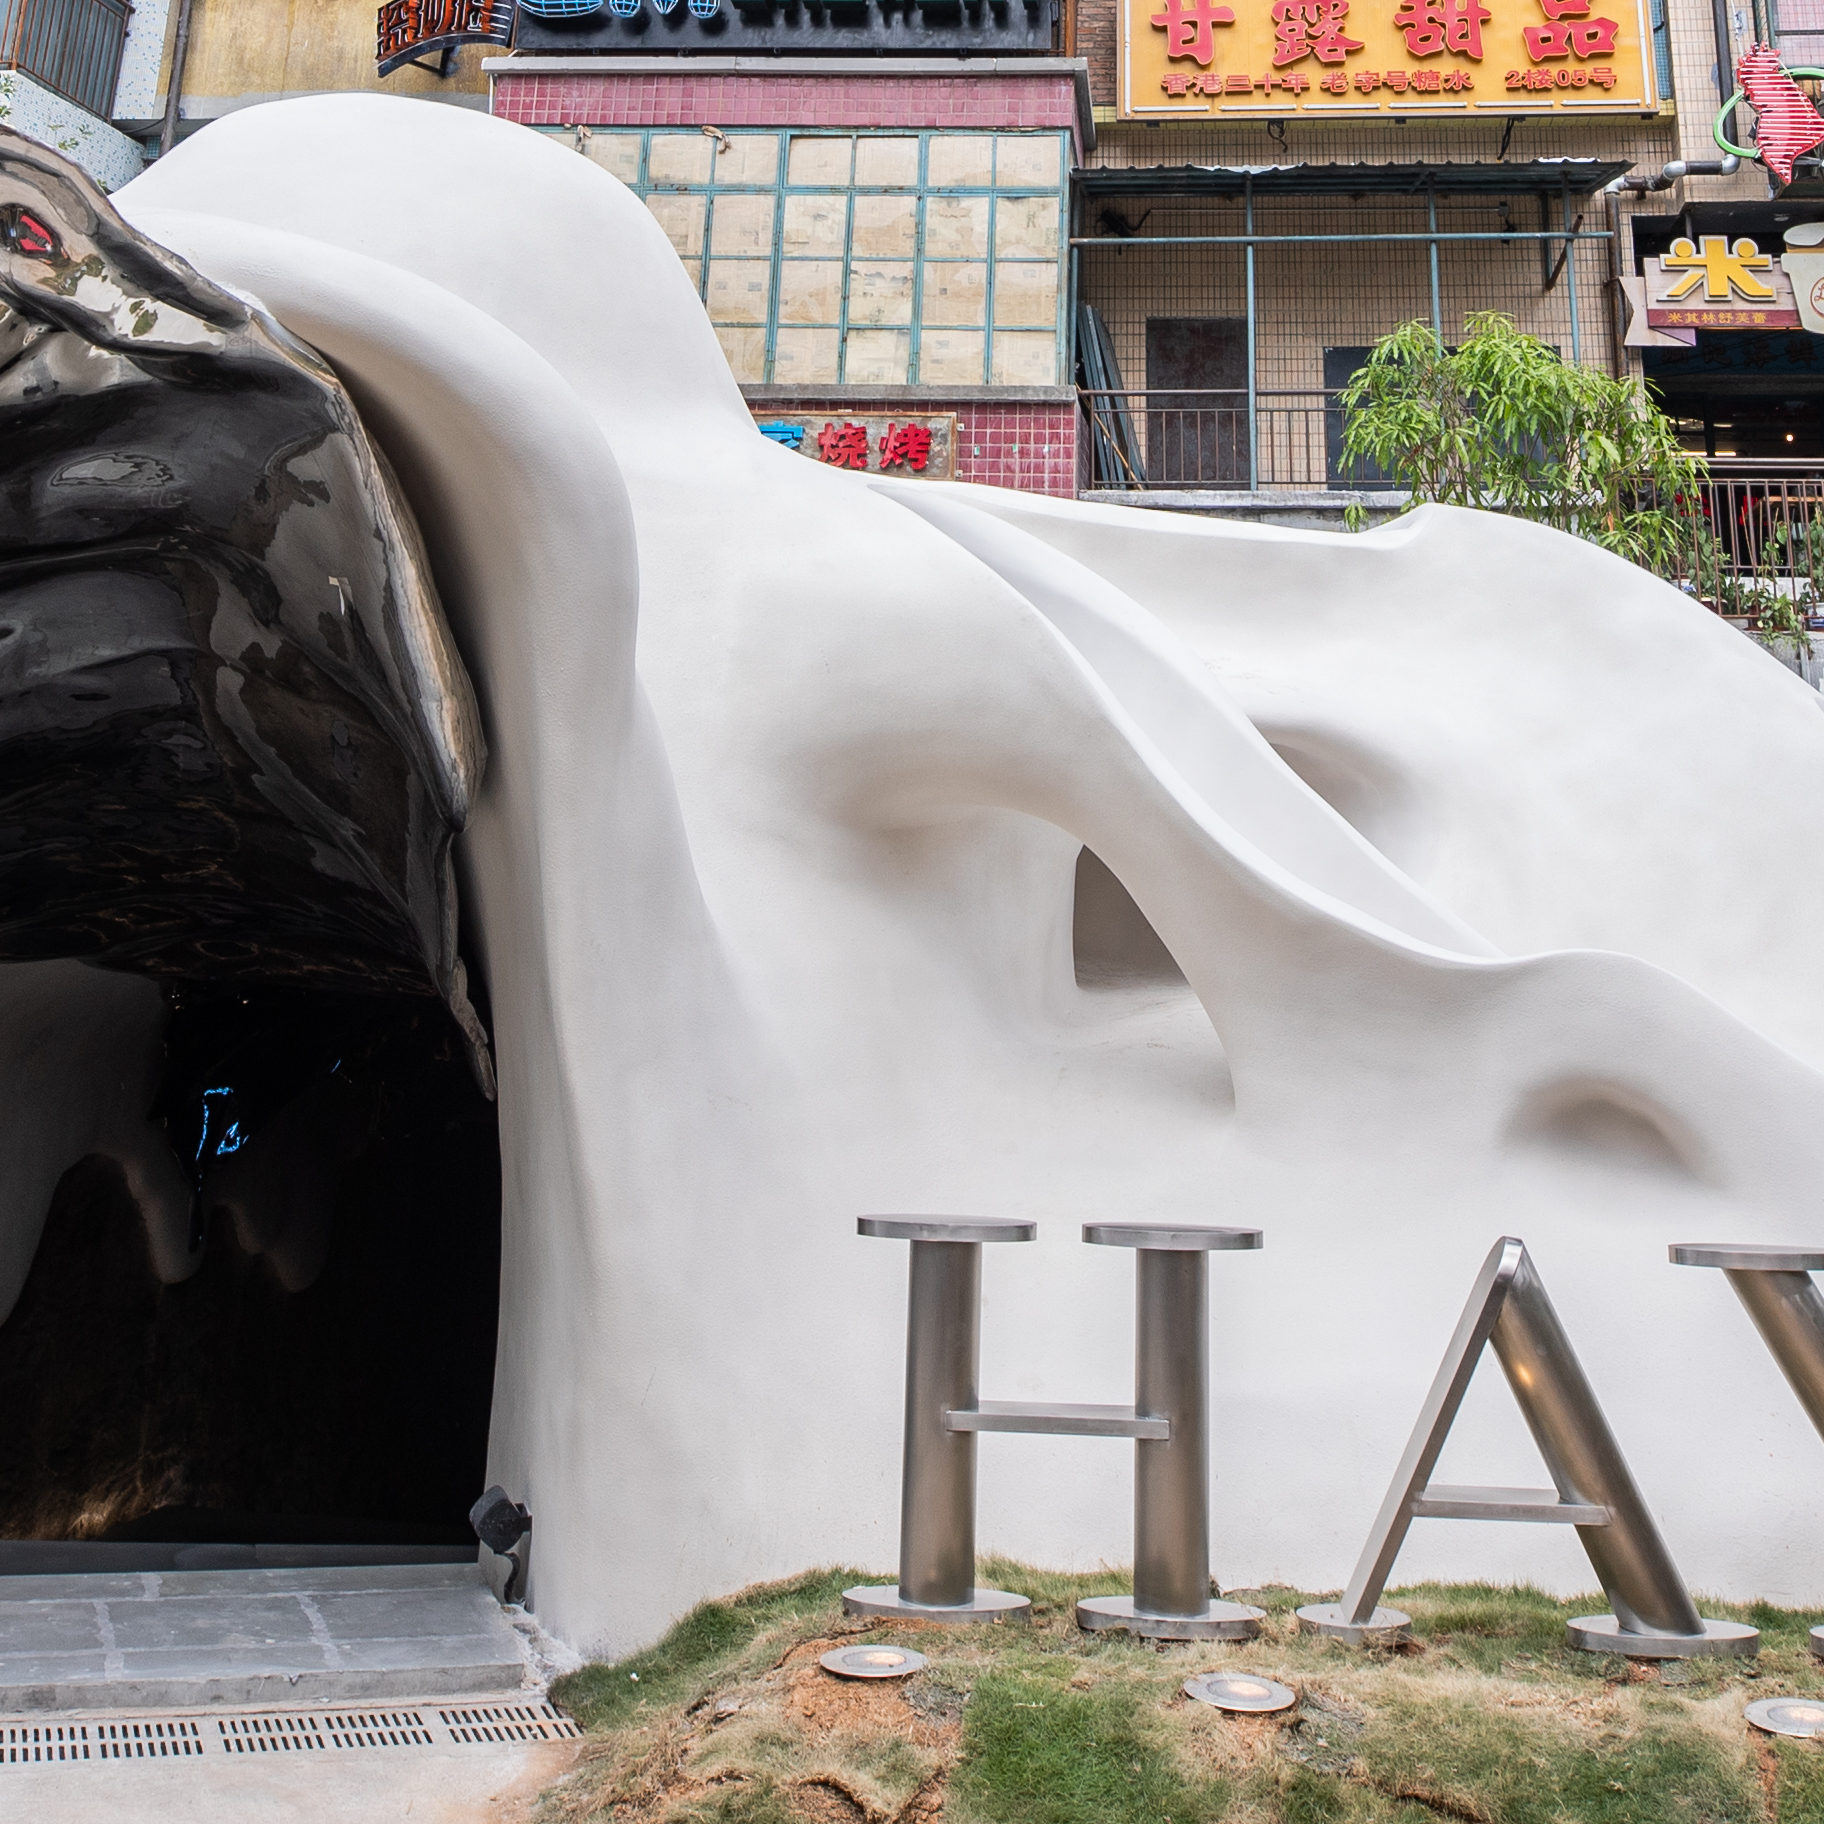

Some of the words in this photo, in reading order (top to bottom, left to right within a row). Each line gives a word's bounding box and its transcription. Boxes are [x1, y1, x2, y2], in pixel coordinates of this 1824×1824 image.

[1161, 71, 1311, 96] 香港三十年
[1320, 68, 1474, 94] 老字号糖水
[1505, 66, 1618, 90] 2楼05号
[1658, 234, 1777, 302] 米
[1667, 310, 1767, 326] 米其林舒芙蕾
